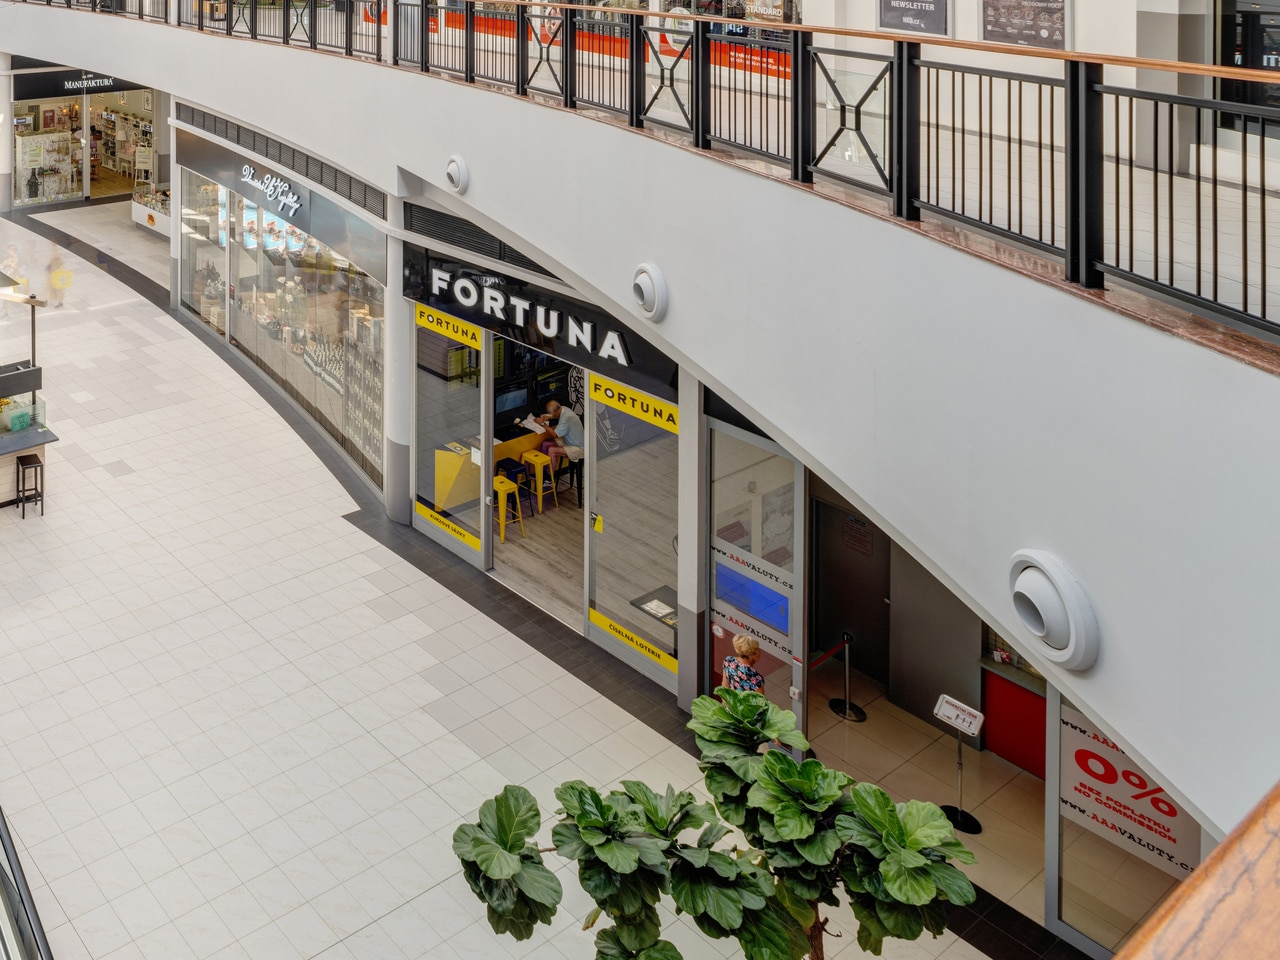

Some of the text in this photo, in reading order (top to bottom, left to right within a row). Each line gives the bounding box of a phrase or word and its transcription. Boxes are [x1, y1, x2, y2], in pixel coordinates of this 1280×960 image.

[746, 5, 783, 17] STANDARD
[891, 0, 935, 11] NEWSLETTER
[64, 78, 114, 90] MANUFAKTURA
[419, 310, 478, 343] FORTUNA
[431, 267, 632, 368] FORTUNA
[593, 381, 677, 427] FORTUNA
[430, 514, 466, 538] KURZOVÉ SÁZKY
[710, 544, 794, 590] www.AAAVALUTY.cz
[608, 623, 662, 660] ČÍSELNÁ LOTERIE
[710, 607, 793, 656] www.AAAVALUTY.cz
[1074, 748, 1178, 818] 0%
[1073, 785, 1178, 845] NO COMMISSION
[1079, 781, 1172, 834] BEZ POPLATKU
